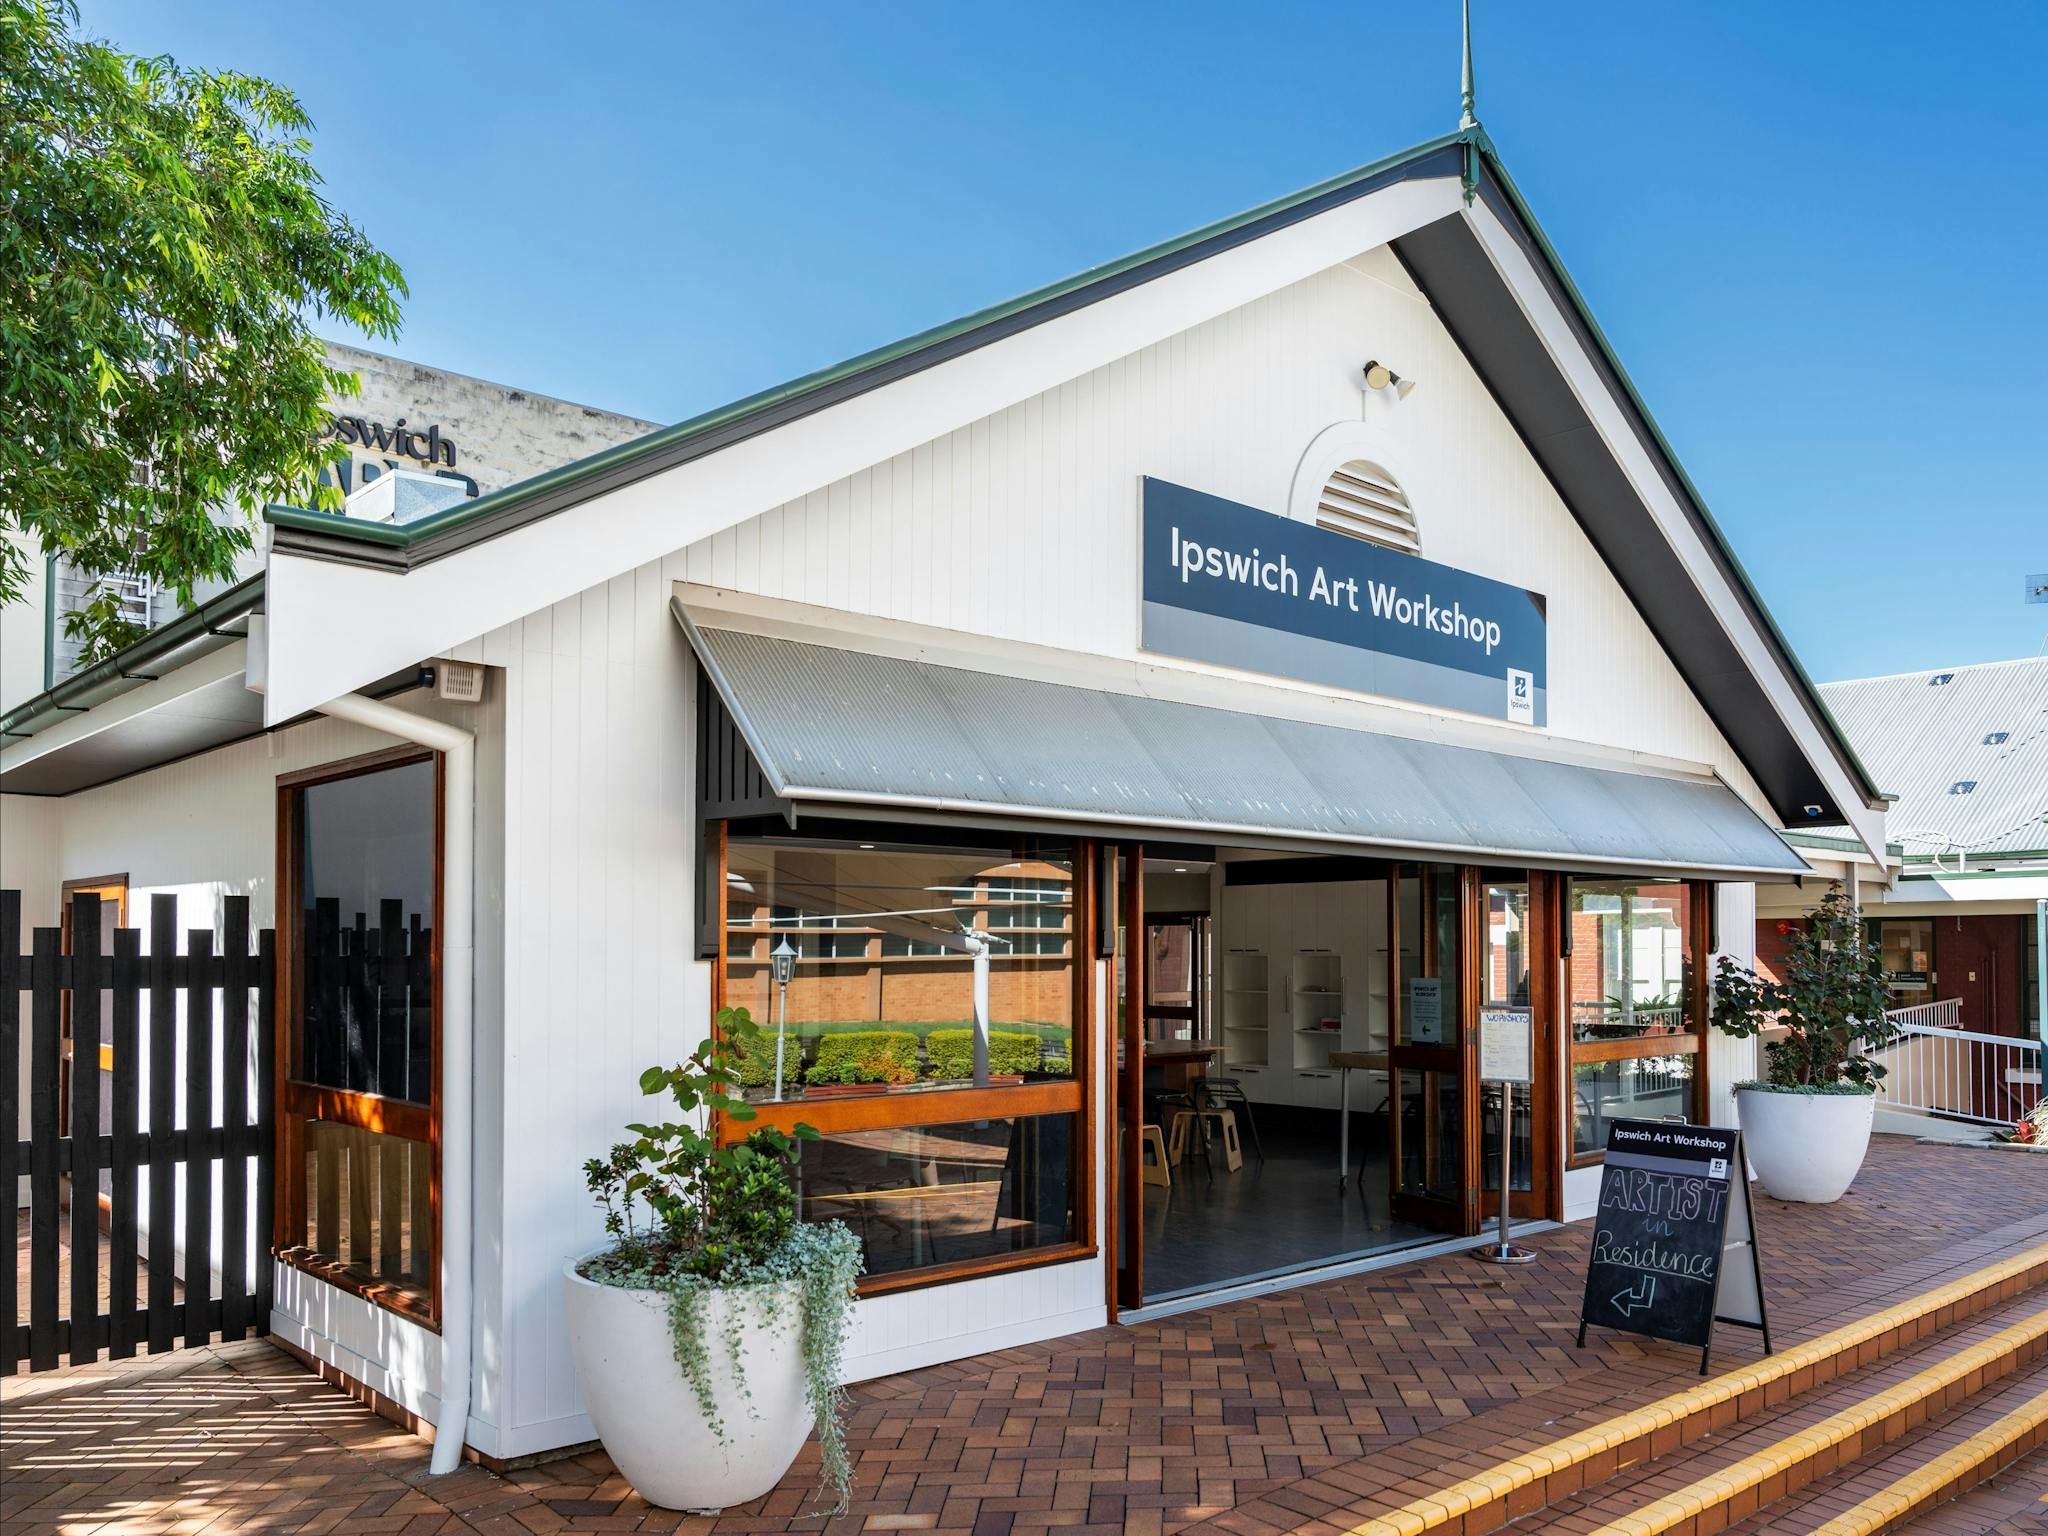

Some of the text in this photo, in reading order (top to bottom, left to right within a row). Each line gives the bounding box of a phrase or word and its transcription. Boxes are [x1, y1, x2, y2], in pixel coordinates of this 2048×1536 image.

[308, 413, 457, 468] pswich
[1171, 526, 1501, 656] Ipswich Art Workshop
[1510, 699, 1531, 710] Ipswich
[1614, 1128, 1727, 1152] Ipswich Art Workshop
[1601, 1168, 1730, 1223] ARTIST
[1642, 1213, 1674, 1236] in
[1593, 1229, 1714, 1278] Residence
